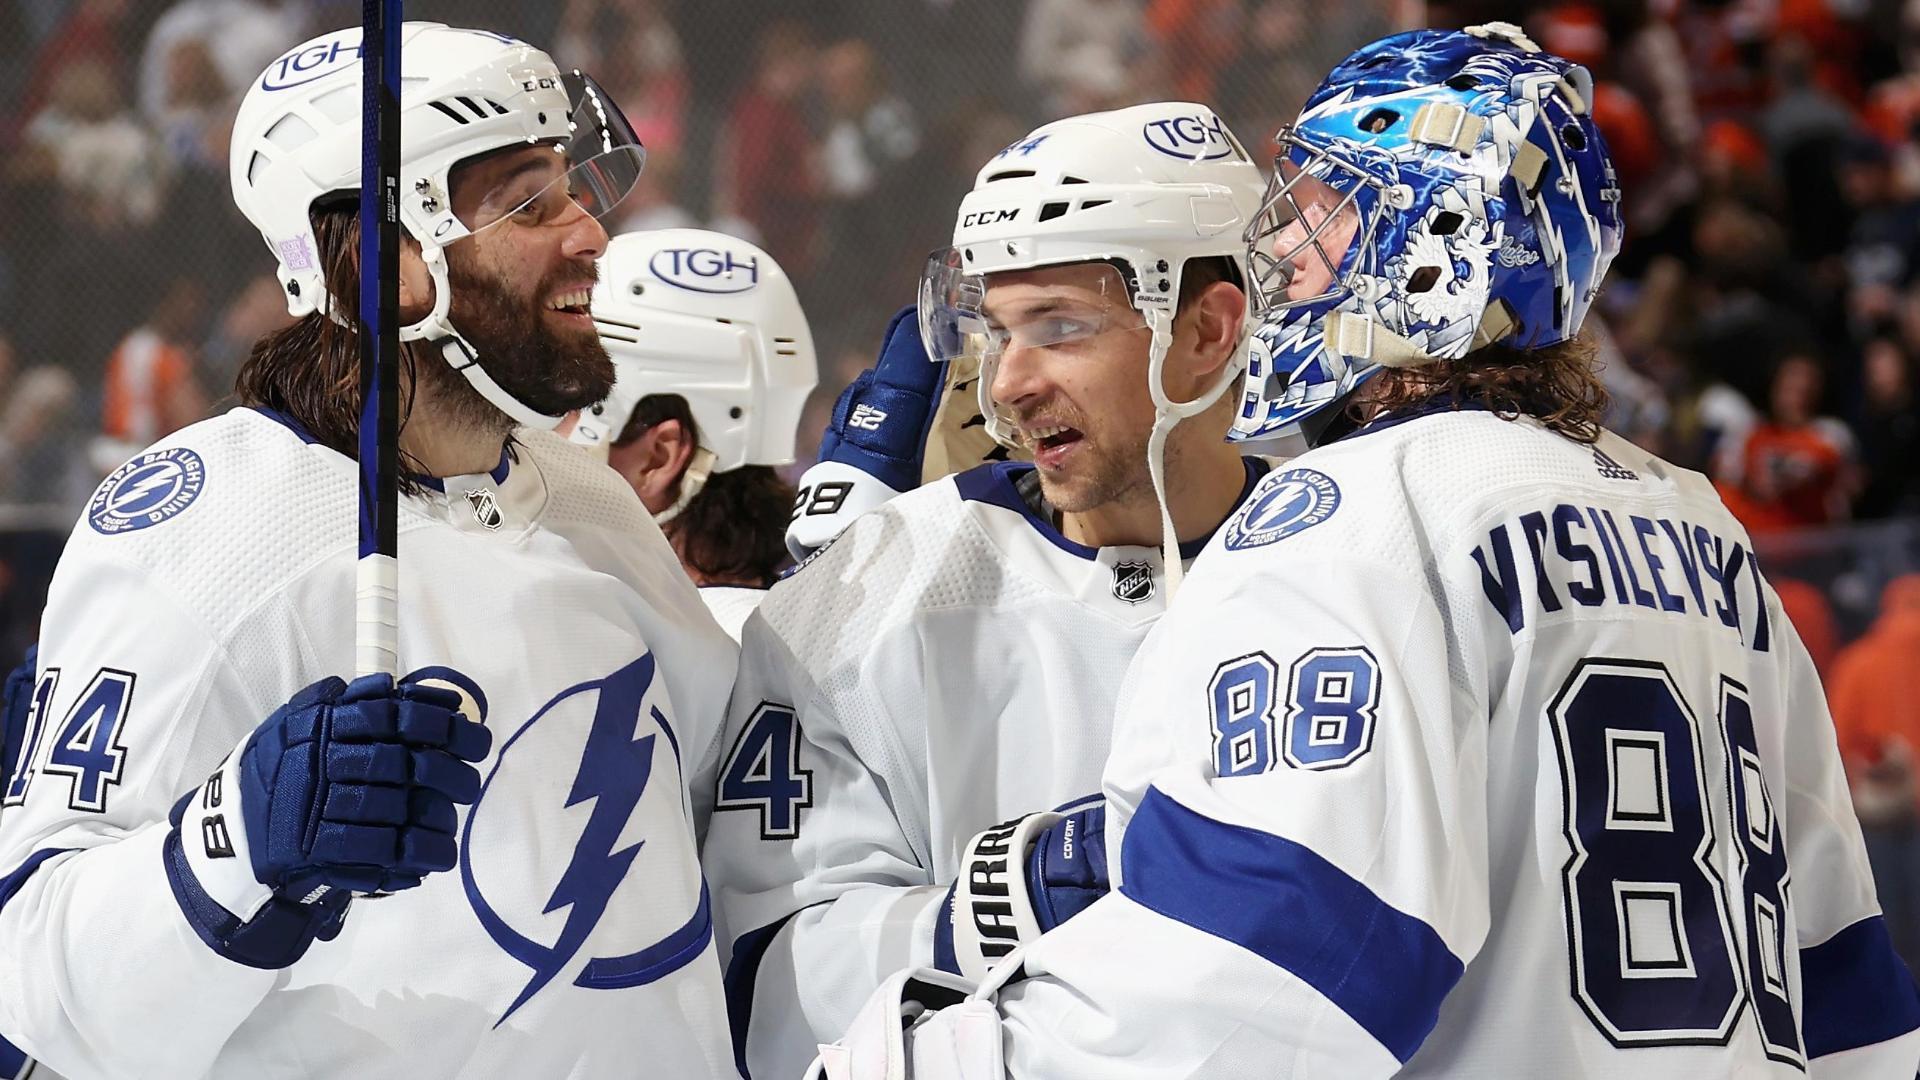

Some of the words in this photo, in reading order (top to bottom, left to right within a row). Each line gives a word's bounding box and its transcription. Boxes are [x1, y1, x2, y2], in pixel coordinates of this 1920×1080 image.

[274, 40, 364, 81] TGH
[1148, 115, 1231, 148] TGH
[963, 208, 1020, 228] CCM
[662, 249, 758, 283] TGH
[143, 449, 179, 464] BAY
[92, 463, 137, 511] TAMPA
[148, 451, 201, 522] LIGHTNING
[1292, 470, 1336, 524] LIGHTNING
[1206, 645, 1383, 778] 88
[1, 666, 137, 814] 14
[1063, 819, 1076, 860] COVERT
[1546, 656, 1807, 1074] 88
